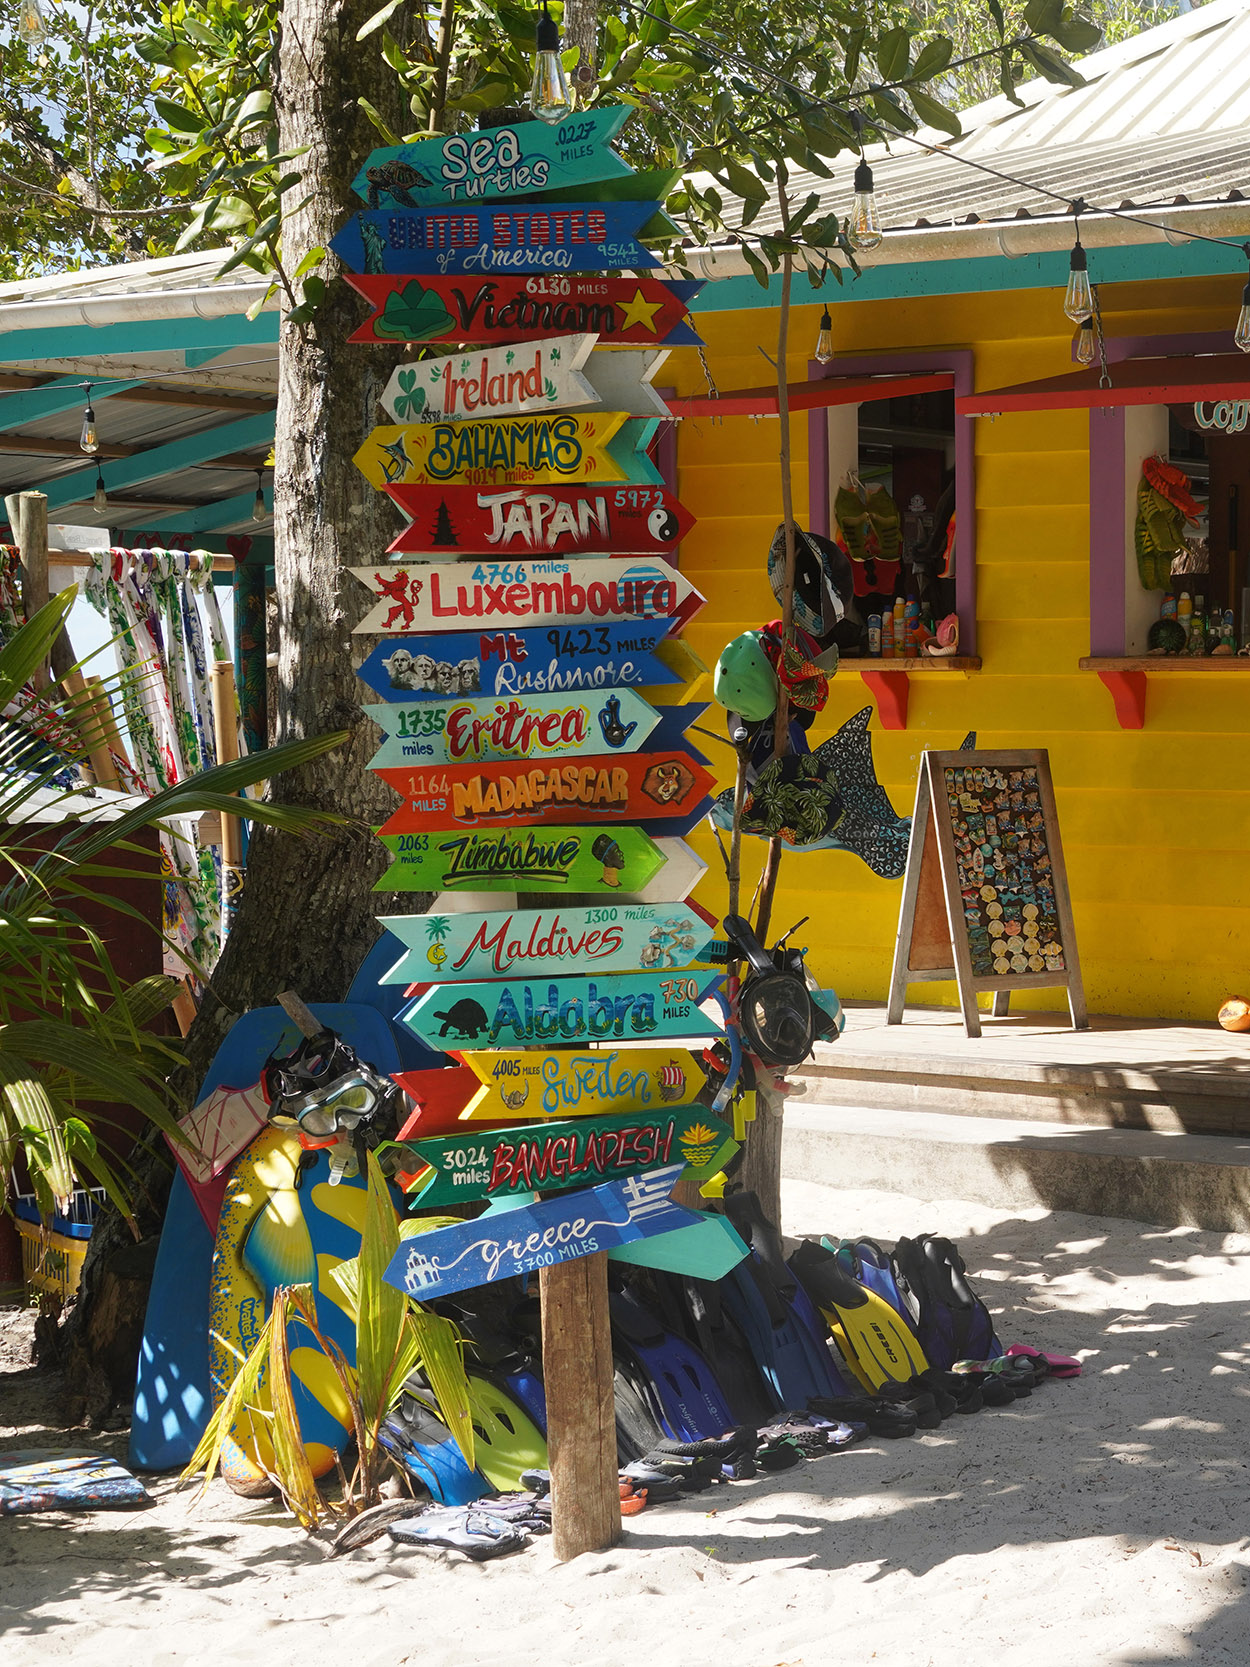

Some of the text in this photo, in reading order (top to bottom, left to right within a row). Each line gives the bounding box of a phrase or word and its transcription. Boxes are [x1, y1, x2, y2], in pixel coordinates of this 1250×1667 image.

[441, 128, 522, 181] Sea
[560, 144, 595, 162] MILES
[441, 160, 550, 201] Turtles
[388, 209, 608, 250] UNITED STATES
[436, 242, 574, 275] of America
[597, 243, 639, 258] 9541
[608, 256, 639, 267] MILES
[525, 278, 609, 296] 6130 MILES
[451, 282, 617, 334] Vietnam
[441, 349, 547, 415] Ireland
[428, 421, 583, 480] BAHAMAS
[464, 466, 535, 486] 9019 miles
[613, 489, 666, 509] 5972
[477, 489, 612, 550] JAPAN
[471, 561, 570, 585] 4766 miles
[430, 572, 677, 620] Luxembourg
[479, 633, 529, 662] Mt
[547, 627, 656, 657] 9423 MILES
[397, 708, 447, 736] 1735
[444, 699, 588, 758] Eritrea
[402, 742, 434, 757] miles
[408, 773, 451, 797] 1164
[452, 766, 630, 818] MADAGASCAR
[412, 799, 447, 812] MILES
[397, 835, 430, 852] 2063
[438, 834, 582, 873] Zimbabwe
[401, 854, 424, 865] miles
[584, 906, 656, 924] 1300 miles
[450, 915, 624, 973] Maldives
[659, 977, 699, 1004] 730
[487, 983, 660, 1044] Aldabra
[662, 1005, 691, 1020] MILES
[491, 1059, 541, 1081] 4005 MILES
[541, 1051, 652, 1114] Sweden
[441, 1146, 489, 1171] 3024
[487, 1121, 676, 1192] BANGLADESH
[452, 1166, 491, 1186] miles
[559, 1237, 599, 1263] MILES
[869, 1321, 899, 1364] CRESSI
[677, 1402, 700, 1434] Dolphin
